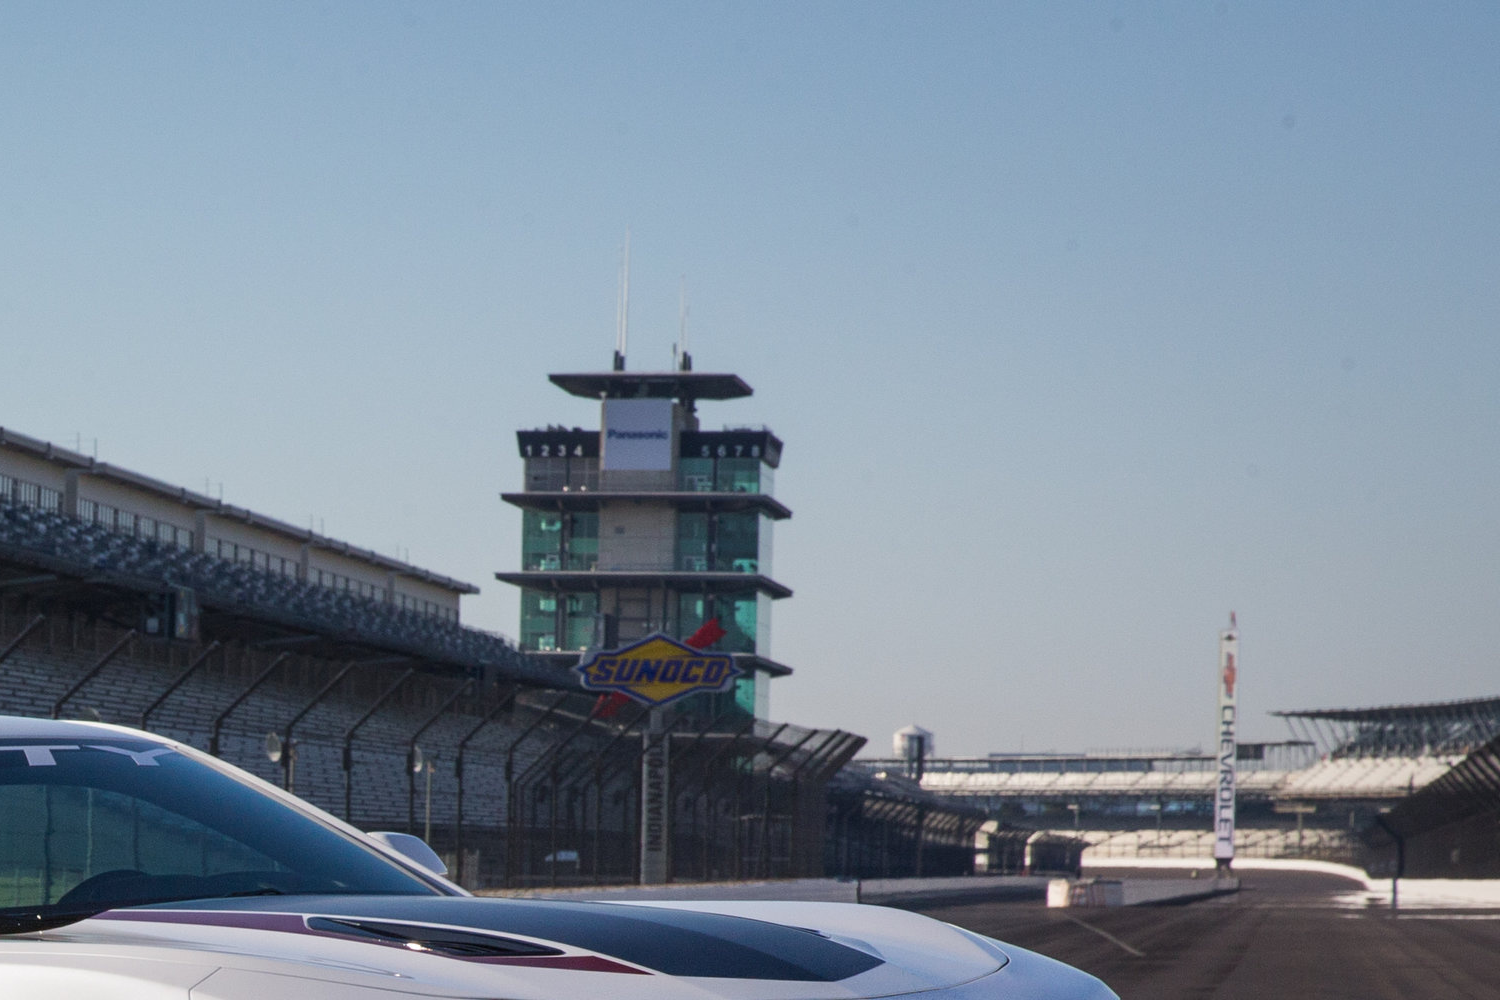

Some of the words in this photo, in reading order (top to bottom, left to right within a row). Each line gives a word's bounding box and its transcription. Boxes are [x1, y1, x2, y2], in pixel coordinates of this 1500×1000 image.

[525, 444, 532, 457] 1
[541, 444, 550, 457] 2
[558, 444, 567, 457] 3
[573, 444, 583, 457] 4
[701, 444, 710, 457] 5
[717, 444, 726, 457] 6
[734, 445, 743, 457] 7
[752, 445, 760, 457] 8
[592, 658, 727, 683] SUNOCO
[1219, 705, 1235, 845] CHEVROLET
